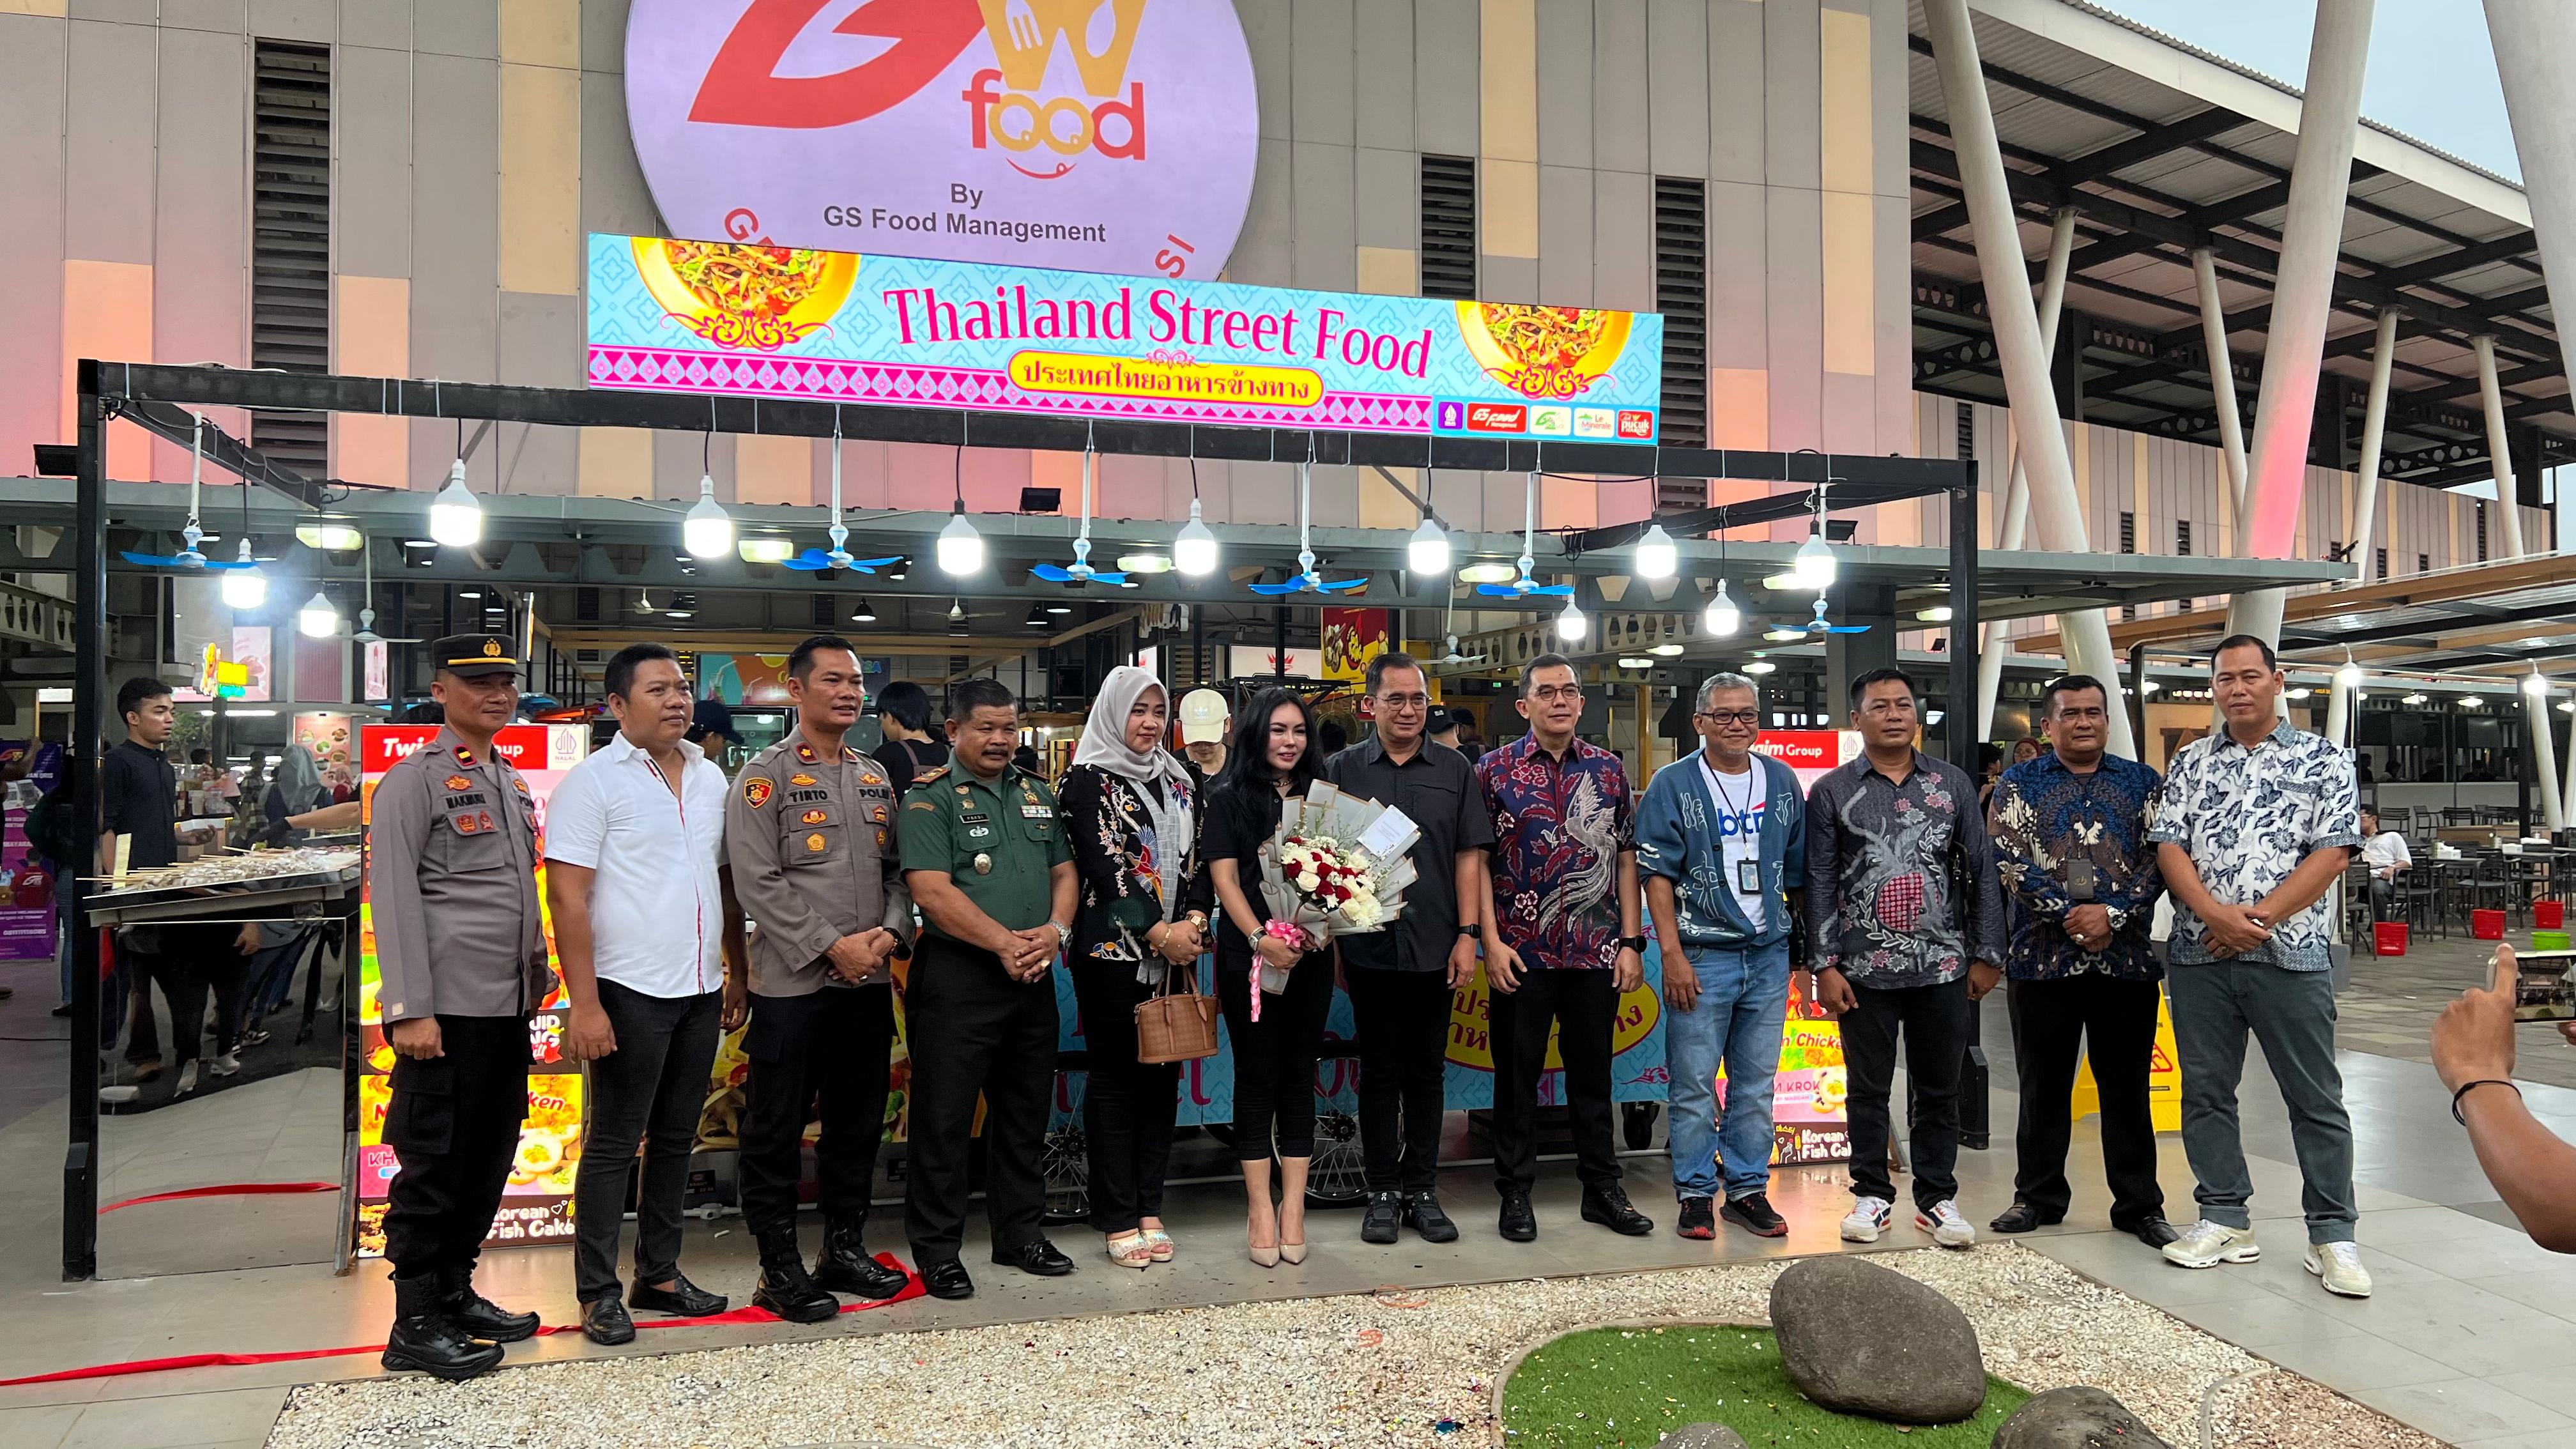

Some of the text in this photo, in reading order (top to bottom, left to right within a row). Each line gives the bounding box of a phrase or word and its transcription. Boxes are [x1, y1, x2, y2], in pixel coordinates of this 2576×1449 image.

[962, 68, 1146, 161] food
[951, 183, 983, 210] By
[824, 206, 1107, 243] GS Food Management
[883, 285, 1432, 378] Thailand Street Food
[1023, 360, 1310, 399] ประเทศไทยอาหารข้างทาง
[1581, 422, 1611, 430] Minerale
[1595, 414, 1604, 422] Le
[383, 737, 425, 757] Twi
[1786, 743, 1823, 758] Group
[790, 789, 828, 803] TIRTO
[1796, 1033, 1842, 1050] Chicke
[1786, 1080, 1820, 1092] KROK
[1802, 1129, 1845, 1144] Korean
[1802, 1143, 1828, 1159] Fish
[528, 1217, 576, 1238] Cake
